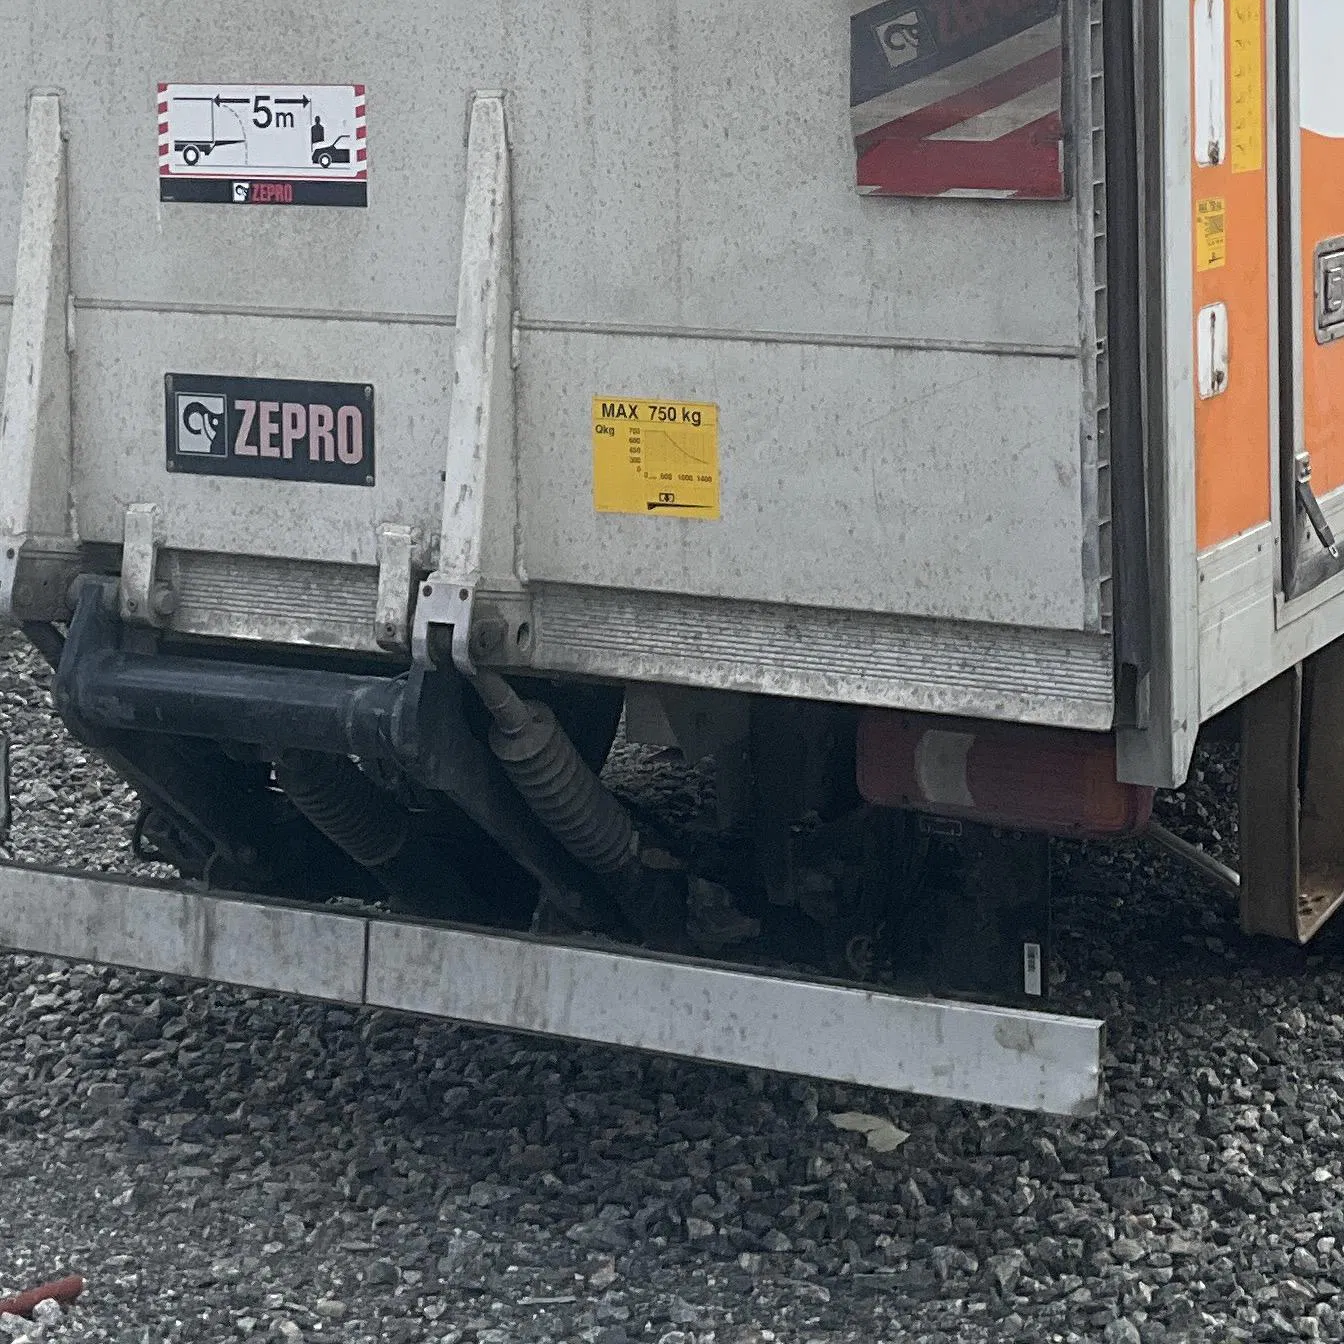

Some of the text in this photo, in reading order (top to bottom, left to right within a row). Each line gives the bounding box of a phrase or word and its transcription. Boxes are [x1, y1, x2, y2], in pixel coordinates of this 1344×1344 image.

[252, 95, 295, 129] 5 m
[251, 183, 293, 203] ZEPRO
[601, 403, 702, 427] MAX 750 kg
[233, 399, 363, 464] ZEPRO
